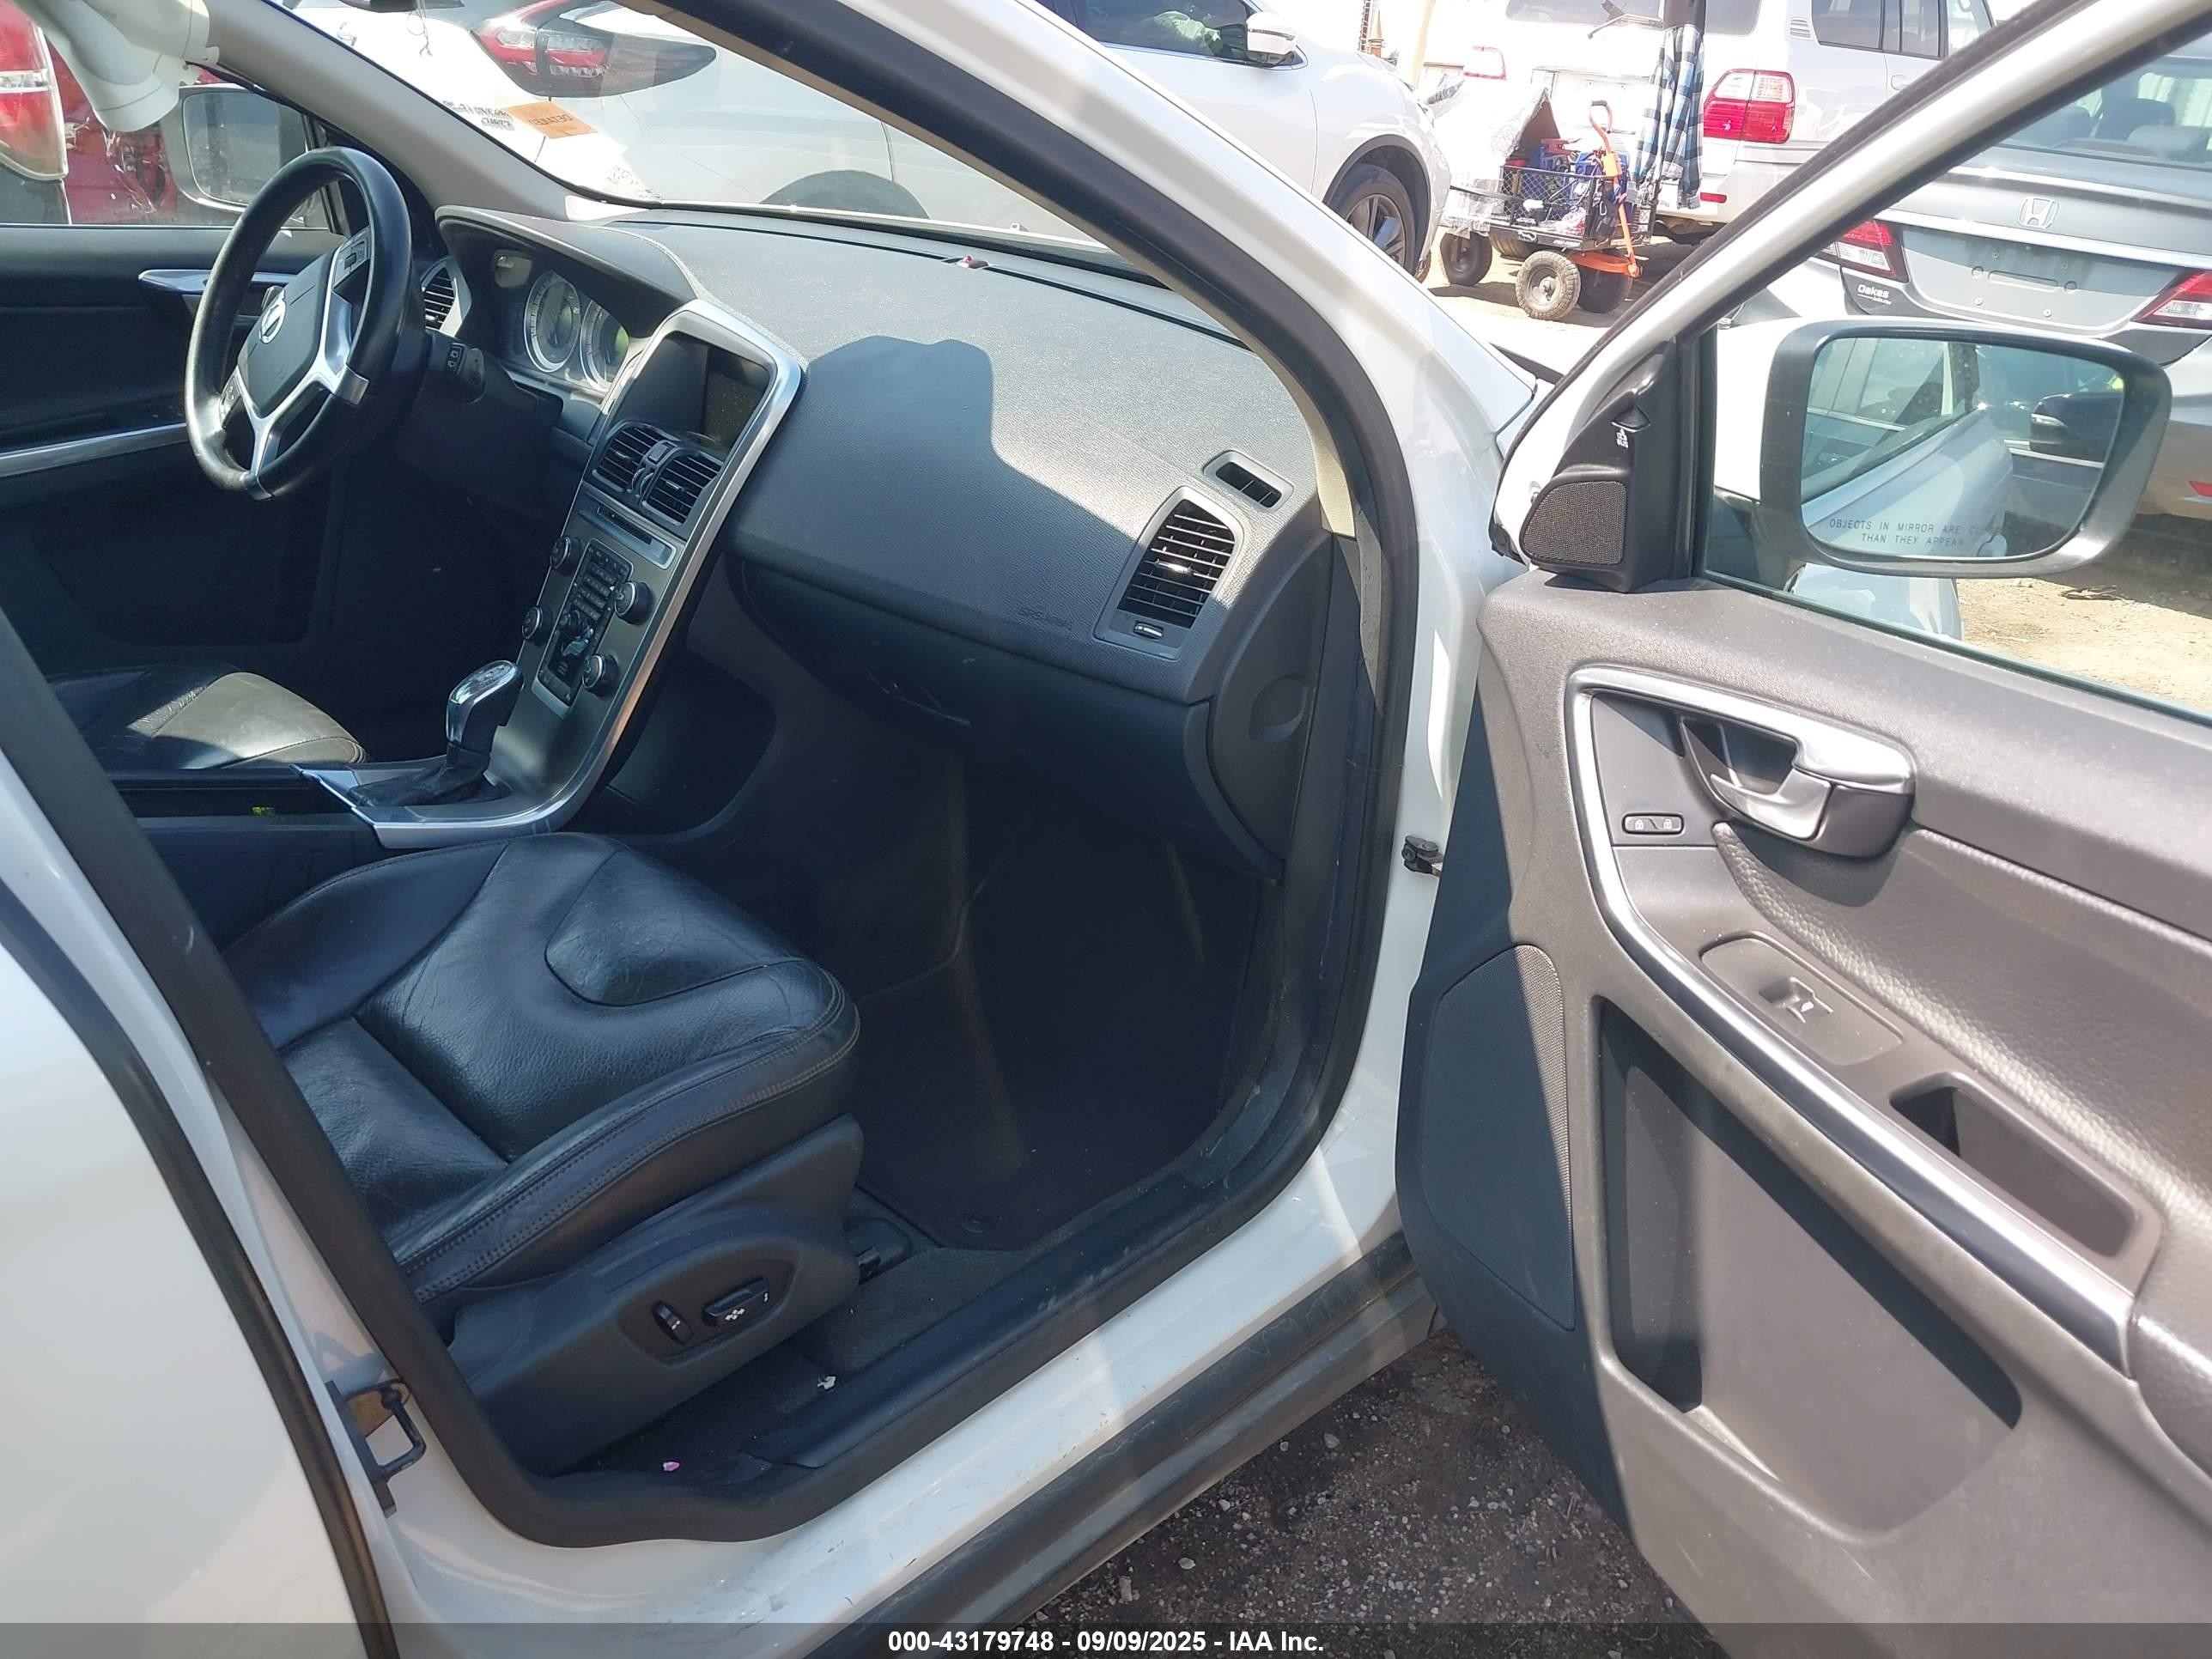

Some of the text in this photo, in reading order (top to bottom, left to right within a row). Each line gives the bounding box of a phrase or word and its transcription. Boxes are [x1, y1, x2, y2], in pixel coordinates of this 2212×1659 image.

[1857, 284, 1889, 299] Oakes
[1829, 518, 1872, 530] OBJECTS
[1880, 521, 1889, 530] IN
[1898, 523, 1935, 533] MIRROR
[1942, 526, 1960, 534] ARE
[1862, 533, 1964, 546] THAN THEY APPEAR
